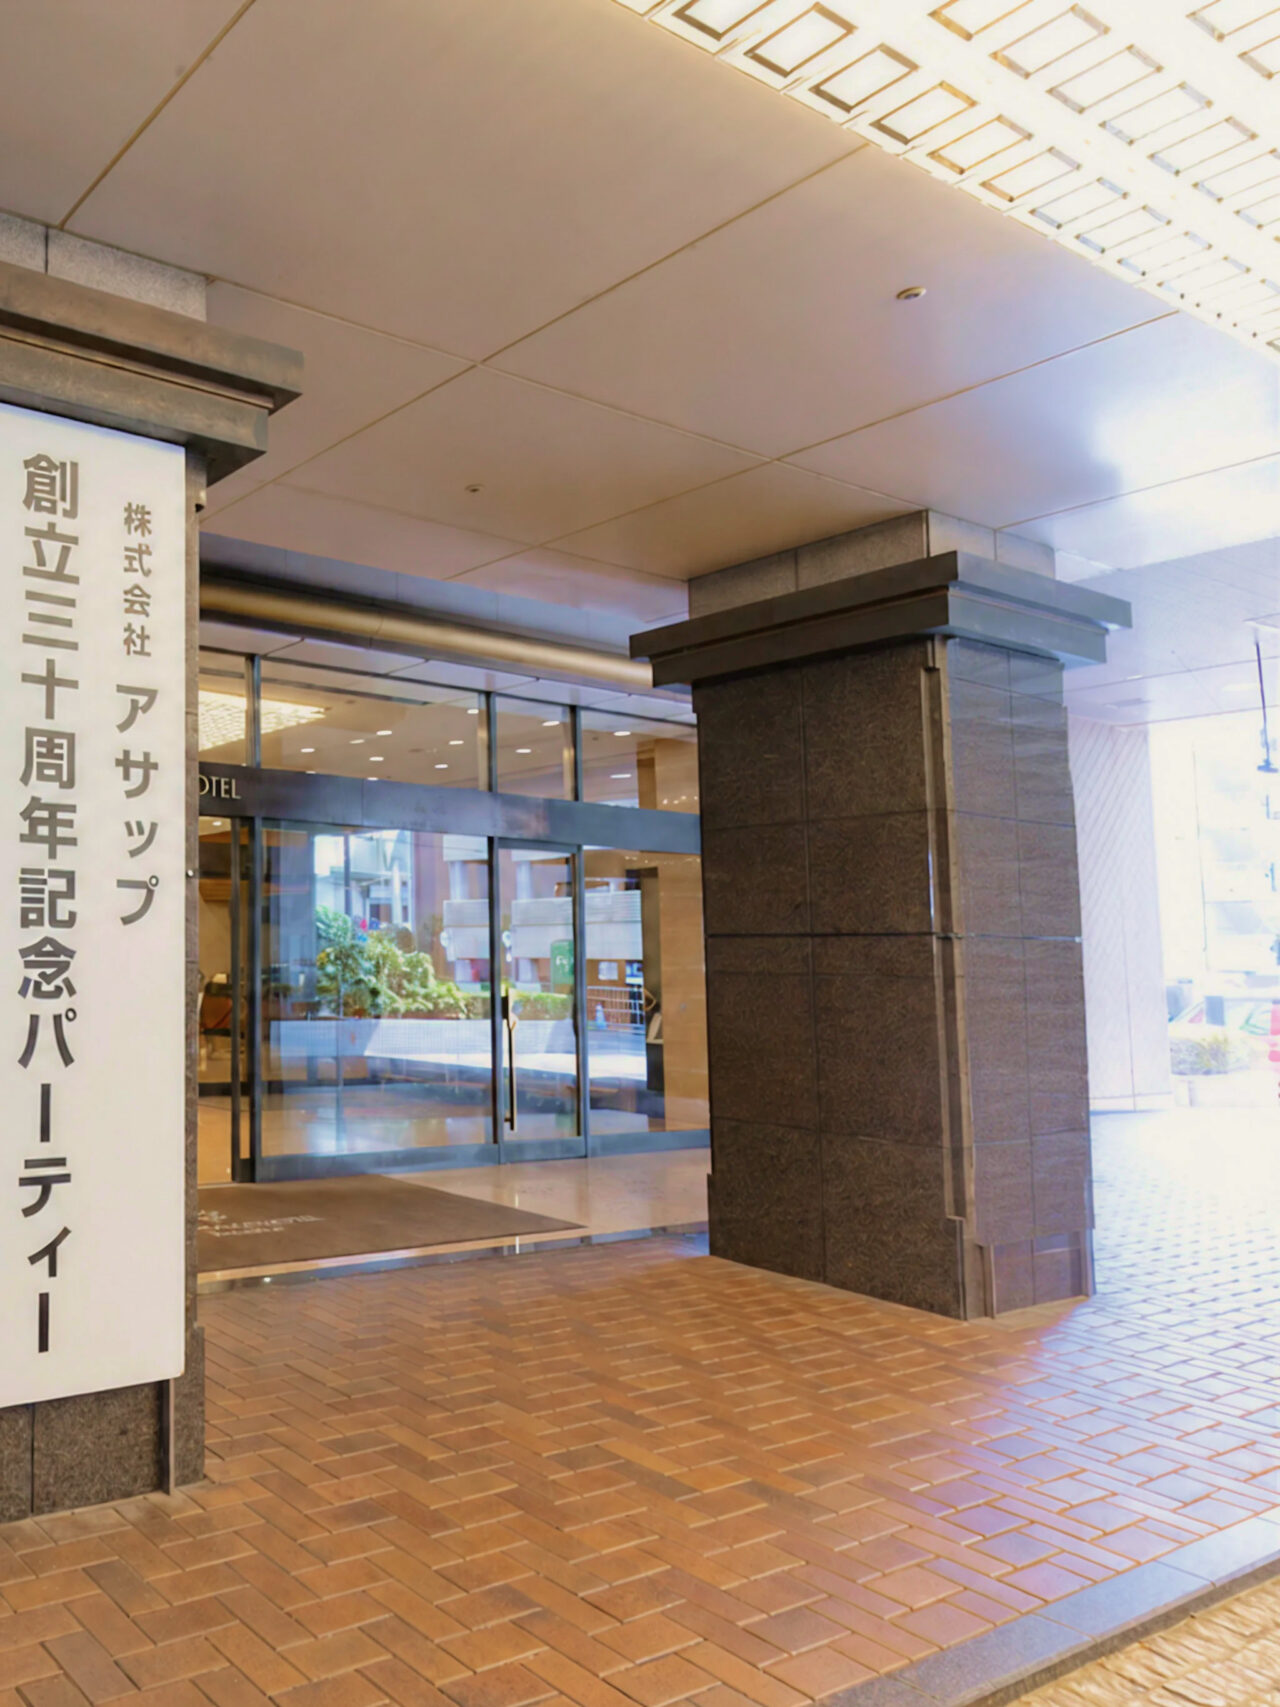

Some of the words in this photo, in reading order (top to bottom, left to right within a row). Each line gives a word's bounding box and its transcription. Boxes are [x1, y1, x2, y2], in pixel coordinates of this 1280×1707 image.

[17, 453, 80, 1354] 創立三十周年記念パーティー
